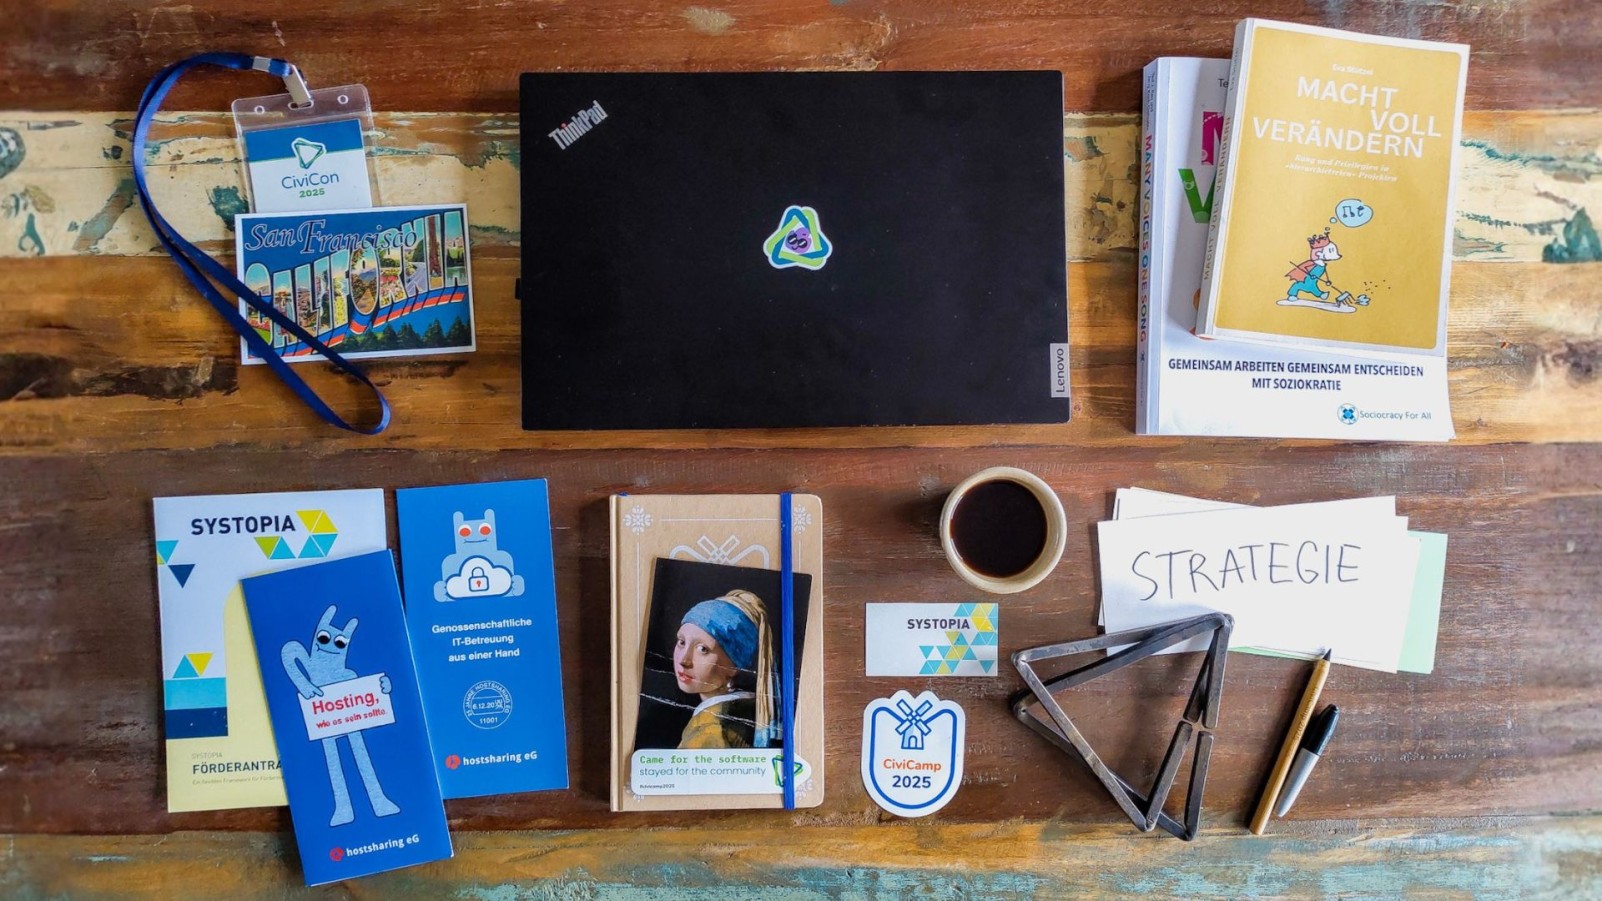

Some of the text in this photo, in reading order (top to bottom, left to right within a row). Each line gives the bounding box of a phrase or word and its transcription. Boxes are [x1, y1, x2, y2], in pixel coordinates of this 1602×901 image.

[1297, 76, 1399, 109] MACHT
[547, 99, 609, 150] ThinkPad
[1370, 109, 1442, 137] VOLL
[1252, 116, 1424, 159] VERÄNDERN
[1144, 133, 1152, 186] MANY
[281, 172, 340, 189] CiviCon
[299, 187, 326, 198] 2025
[1142, 189, 1151, 251] VOICES
[244, 219, 418, 254] San Francisco
[1203, 237, 1214, 281] MACHT
[244, 210, 469, 348] CALIFORNIA
[1141, 254, 1149, 291] ONE
[1140, 295, 1148, 342] SONG
[1056, 348, 1065, 393] Lenovo
[1168, 358, 1424, 377] GEMEINSAM ARBEITEN GEMEINSAM ENTSCHEIDEN
[1252, 378, 1342, 391] MIT SOZIOKRATIE
[1360, 410, 1432, 420] Sociocracy For All
[191, 515, 296, 535] SYSTOPIA
[1132, 540, 1362, 601] STRATEGIE
[432, 618, 533, 633] Genossenschaftliche
[907, 619, 970, 630] SYSTOPIA
[452, 635, 514, 646] IT-Betreuung
[448, 648, 520, 662] aus einer Hand
[312, 692, 380, 715] Hosting,
[316, 719, 331, 729] wie
[345, 713, 361, 723] sein
[191, 752, 223, 760] SYSTOPIA
[463, 751, 538, 766] hostsharing eG
[640, 754, 767, 764] Came for the software
[883, 758, 942, 773] CiviCamp
[639, 766, 767, 778] stayed for the community
[892, 775, 931, 789] 2025
[346, 834, 420, 856] hostsharing eG
